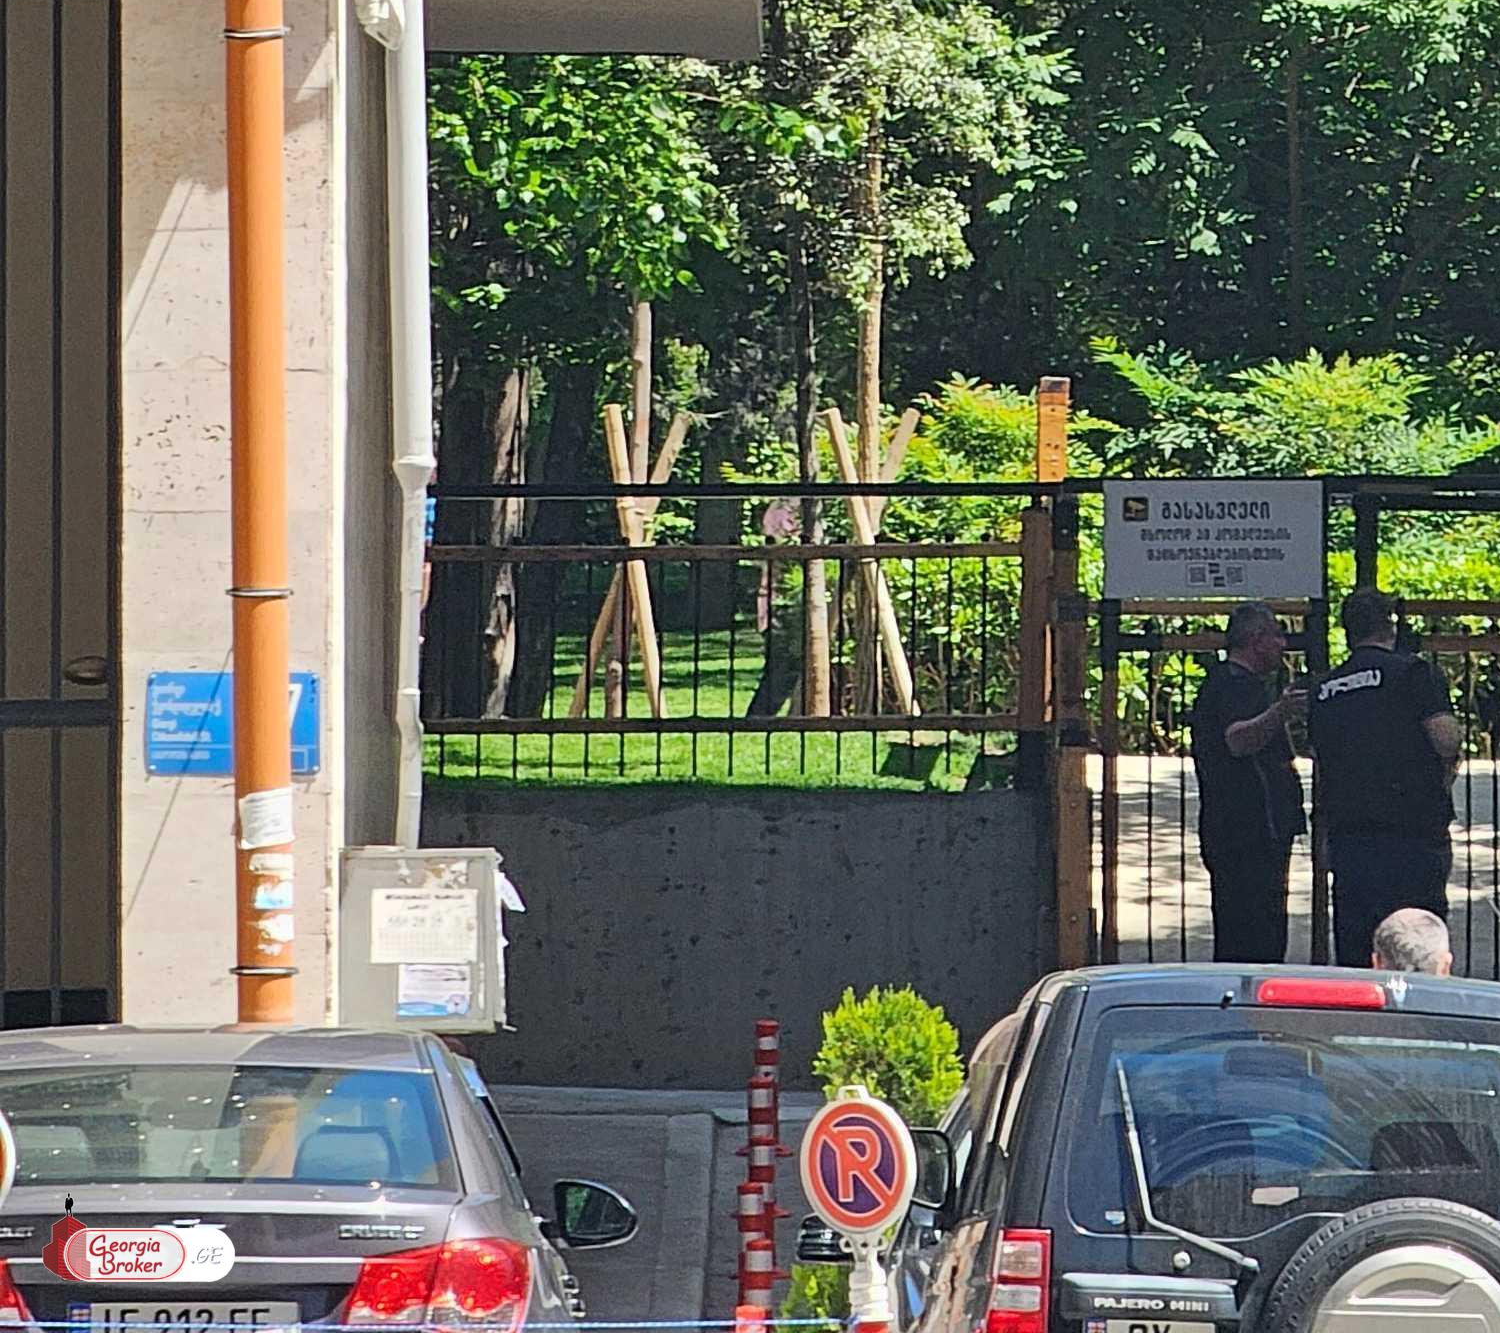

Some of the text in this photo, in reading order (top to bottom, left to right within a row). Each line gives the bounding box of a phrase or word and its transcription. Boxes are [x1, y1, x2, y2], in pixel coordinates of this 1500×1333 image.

[1161, 501, 1271, 520] გასასვლელი
[1093, 1297, 1210, 1312] PAJERO MINI
